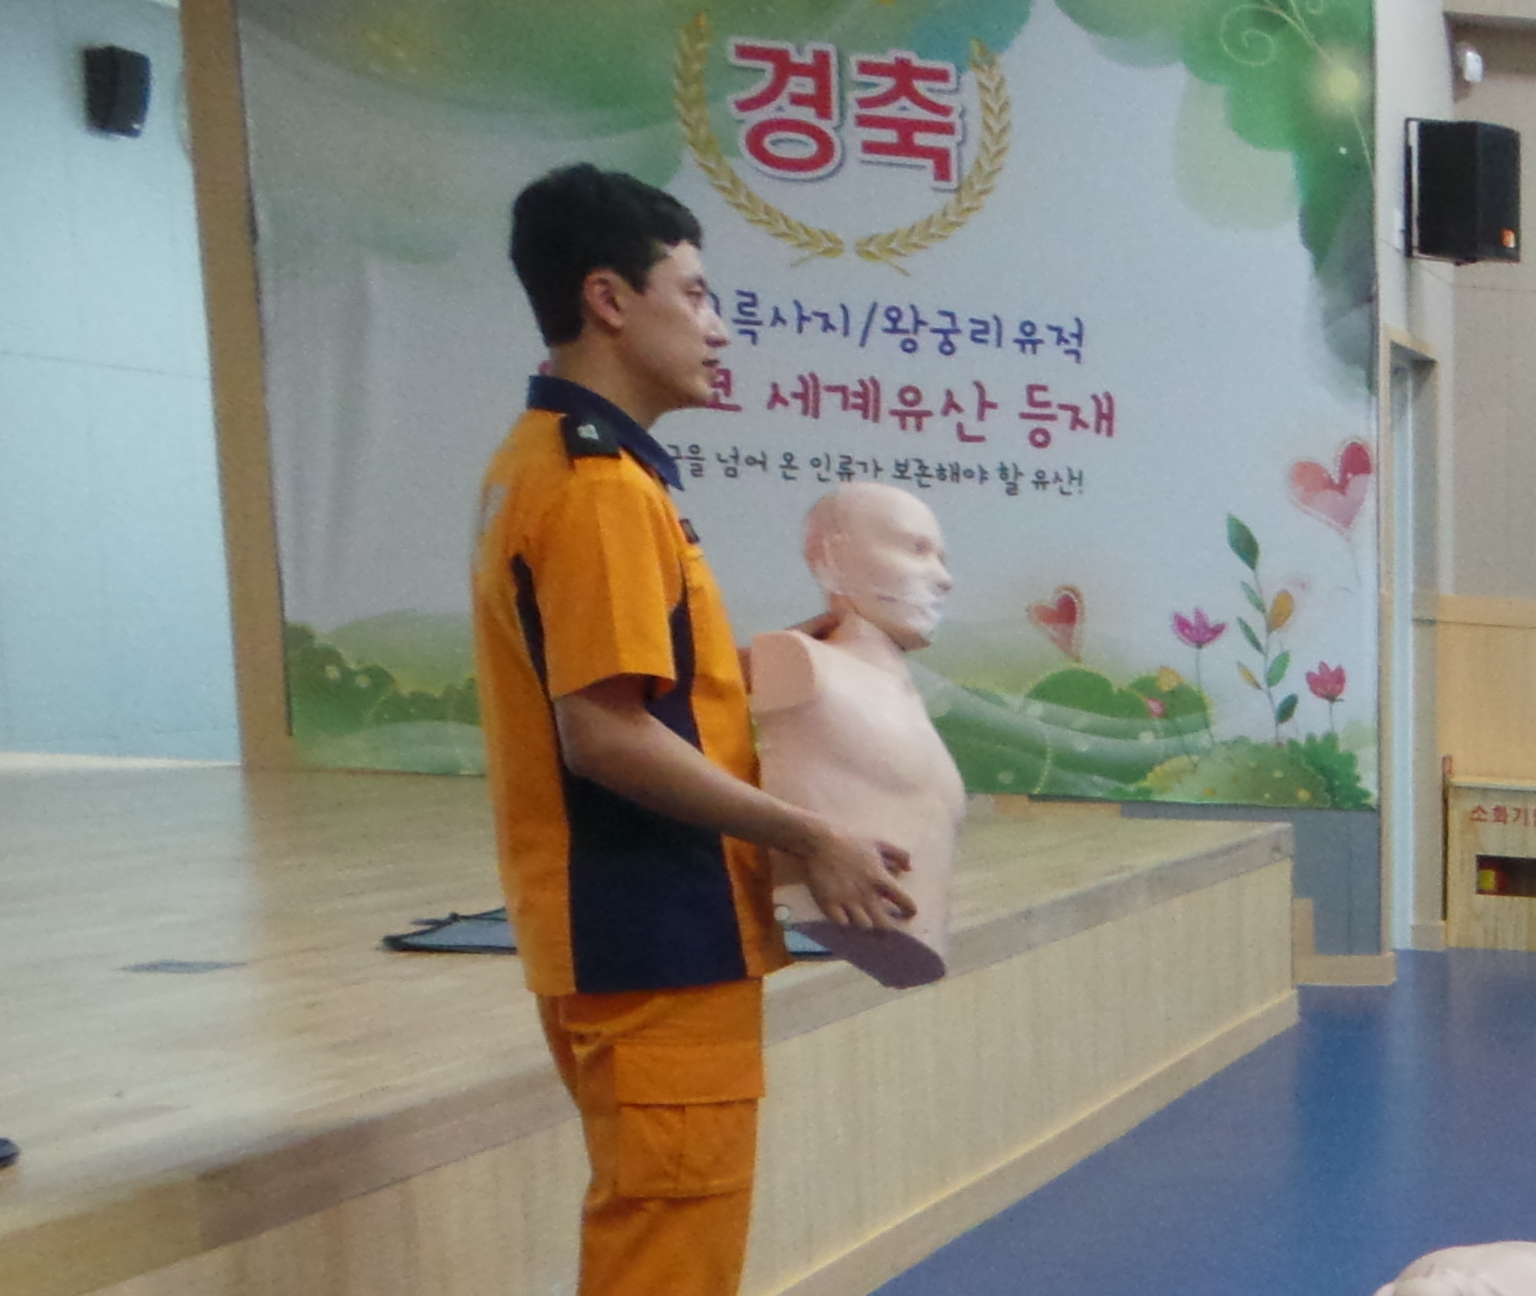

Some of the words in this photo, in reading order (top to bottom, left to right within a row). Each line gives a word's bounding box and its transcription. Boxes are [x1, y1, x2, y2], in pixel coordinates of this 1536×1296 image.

[730, 41, 960, 186] 경축
[765, 371, 999, 443] 세계유산
[1018, 383, 1115, 449] 등재
[715, 446, 768, 478] 넘어
[779, 451, 799, 481] 온
[809, 452, 884, 483] 인류가
[891, 457, 990, 489] 보존해야
[996, 460, 1024, 496] 할
[1031, 465, 1084, 496] 유산!
